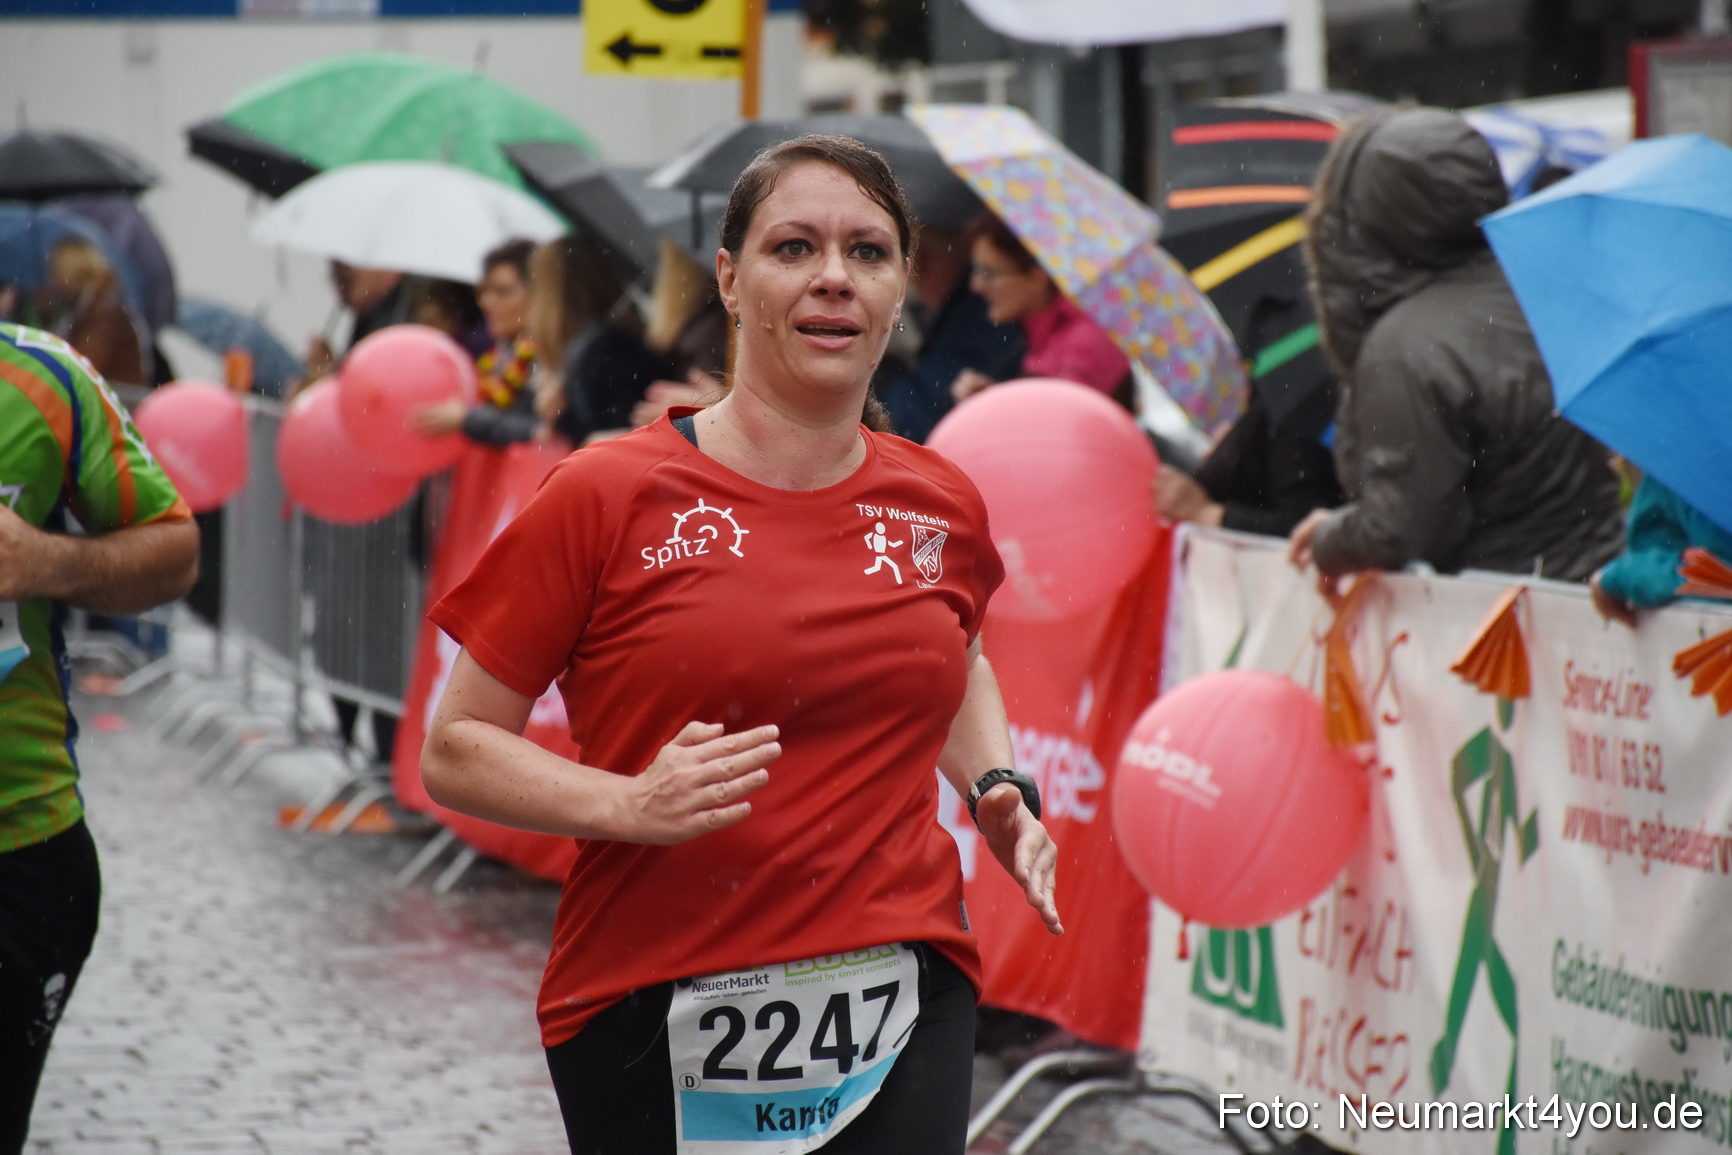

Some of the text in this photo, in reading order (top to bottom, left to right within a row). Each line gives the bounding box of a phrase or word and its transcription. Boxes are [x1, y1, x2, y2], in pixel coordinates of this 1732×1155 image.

[855, 503, 950, 529] TSV Wolfstein
[641, 538, 710, 570] Spitz
[692, 973, 770, 993] NeuerMarkt
[785, 958, 901, 987] inspired by smart concepts
[698, 980, 901, 1082] 2247
[684, 1075, 695, 1088] D
